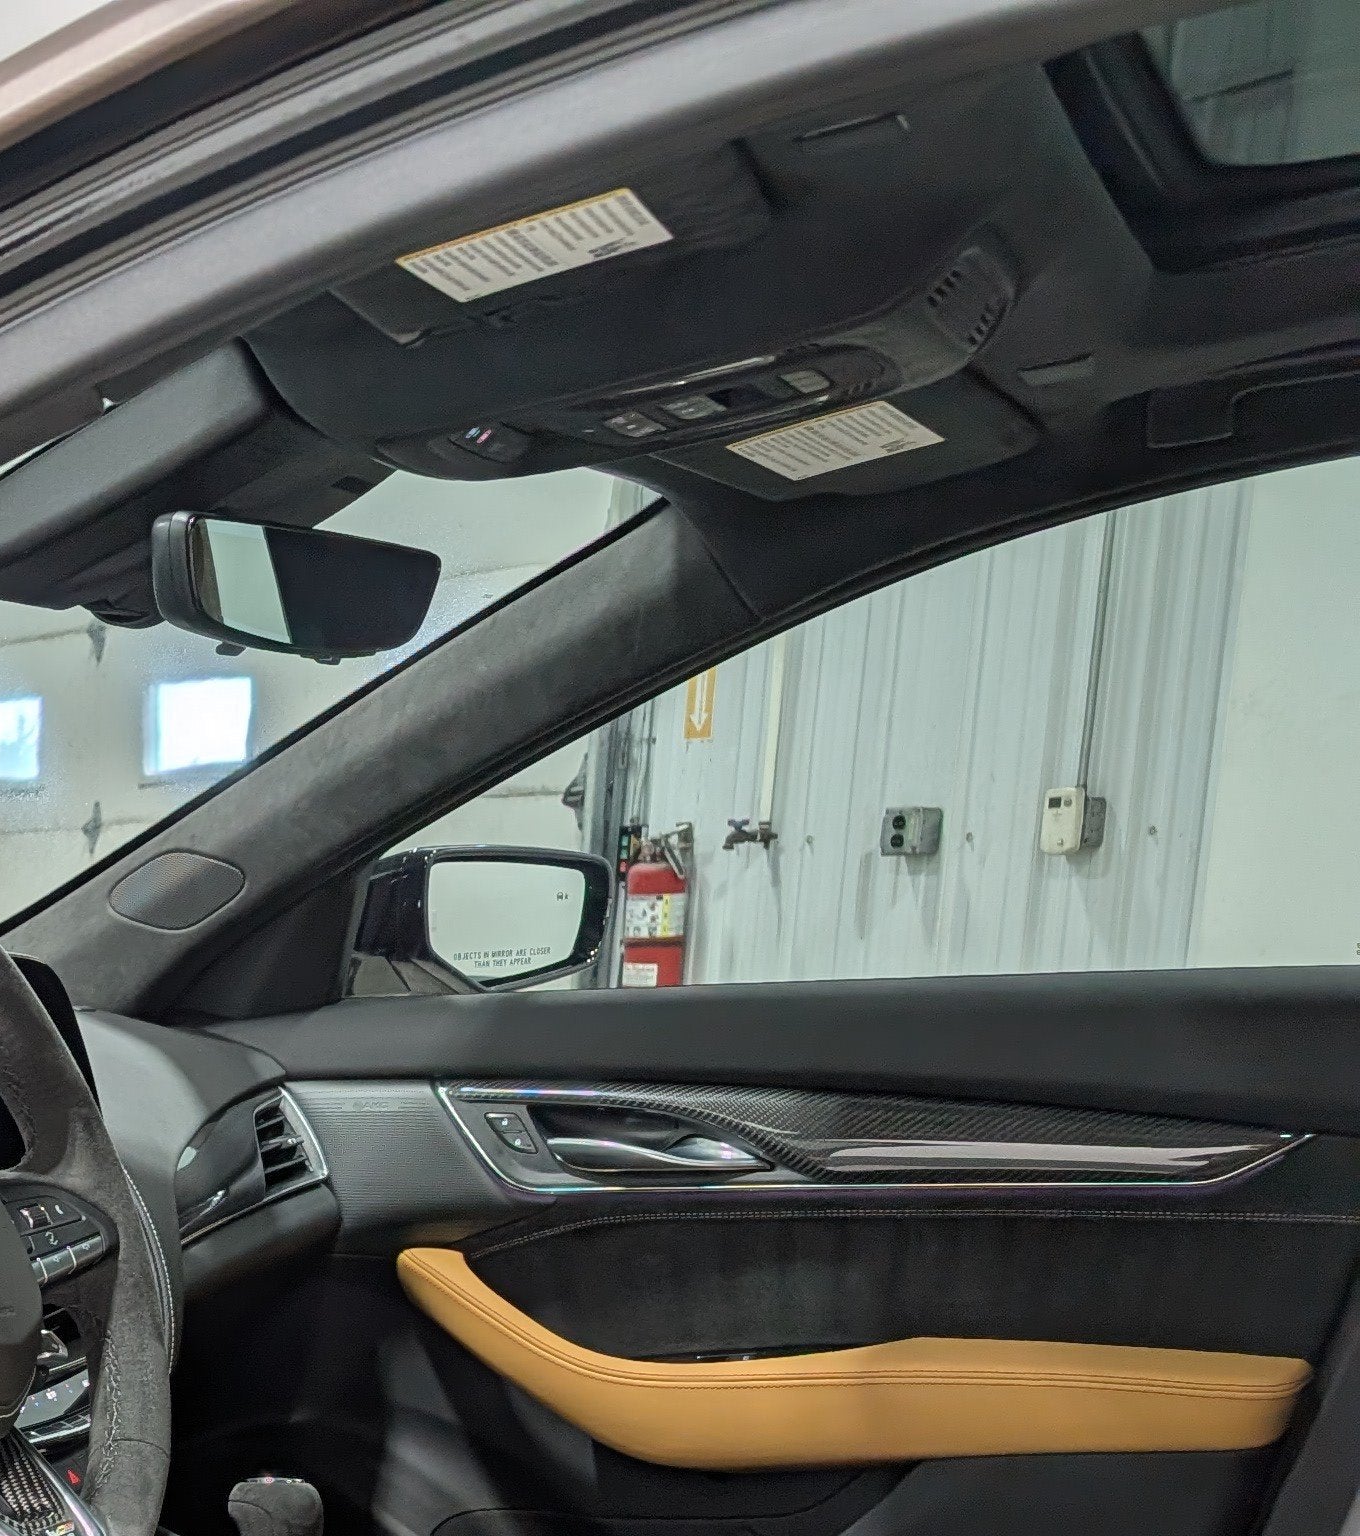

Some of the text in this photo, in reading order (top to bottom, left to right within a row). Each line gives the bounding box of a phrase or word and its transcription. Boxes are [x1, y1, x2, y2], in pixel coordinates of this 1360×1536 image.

[453, 952, 481, 960] OBJECTS
[492, 949, 513, 957] MIRROR
[516, 948, 527, 956] ARE
[530, 947, 551, 955] CLOSER
[474, 957, 531, 968] THAN THEY APPEAR
